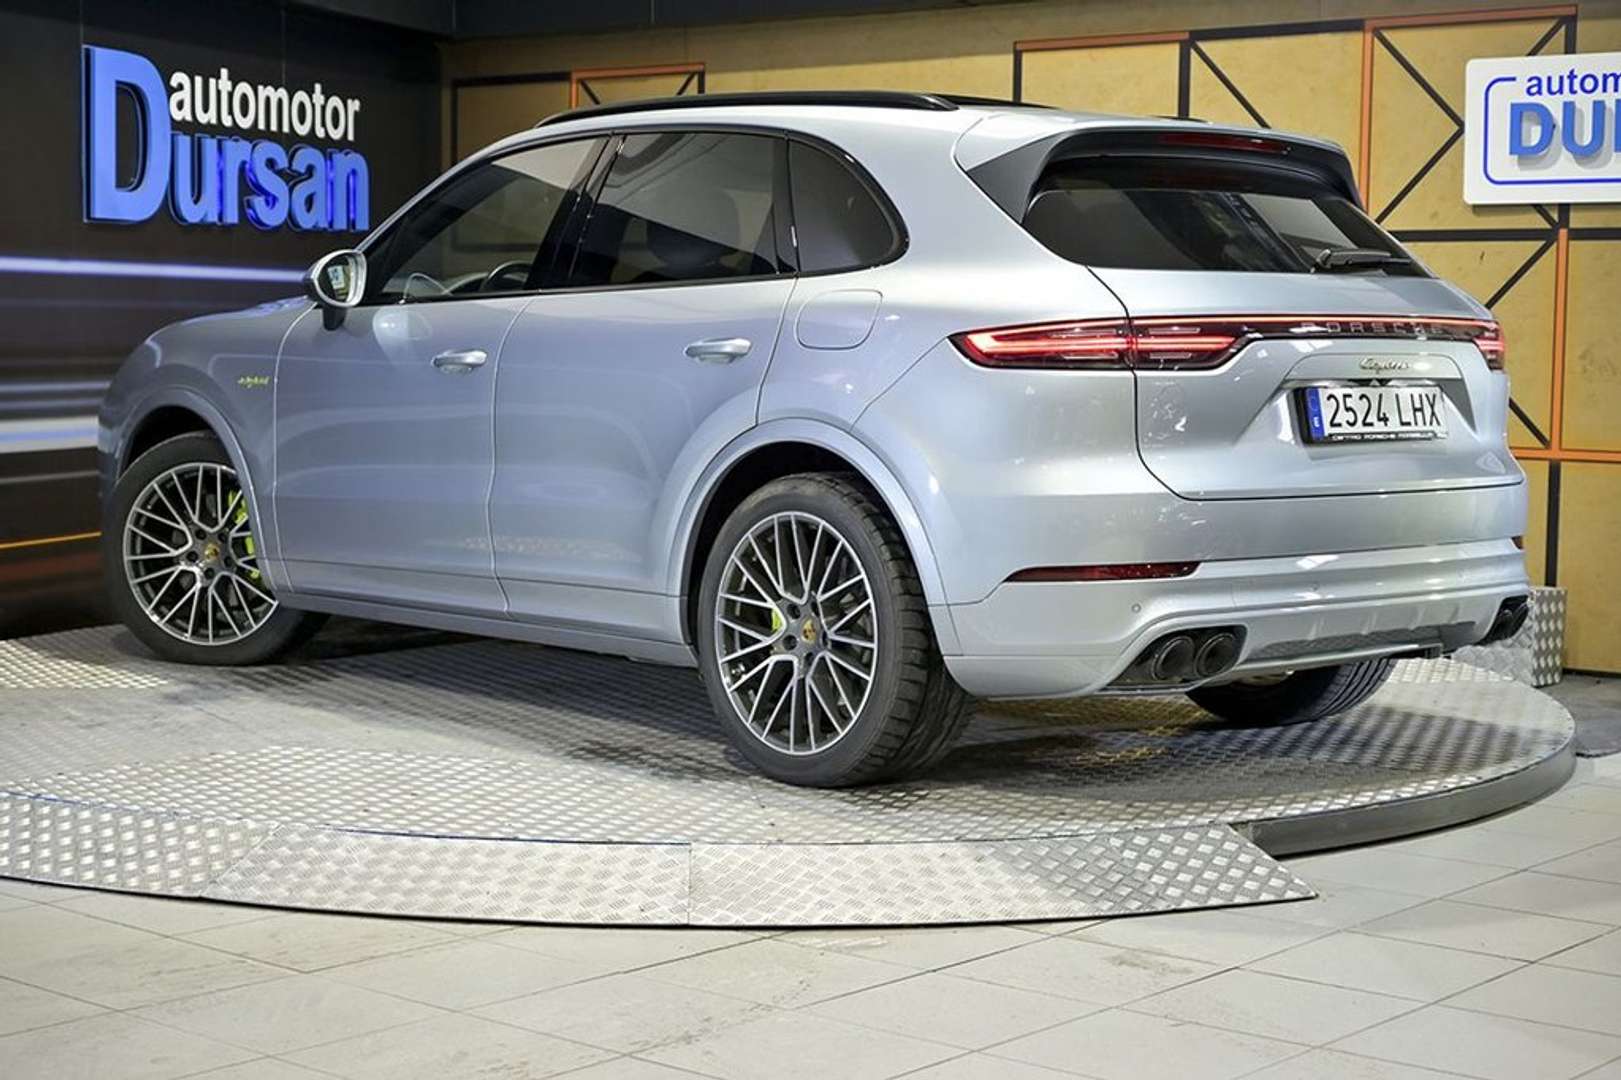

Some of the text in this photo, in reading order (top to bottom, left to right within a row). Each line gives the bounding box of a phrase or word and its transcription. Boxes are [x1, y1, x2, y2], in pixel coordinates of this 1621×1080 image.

[169, 67, 360, 141] automotor
[1509, 99, 1621, 157] DU
[82, 44, 370, 231] Dursan
[1327, 393, 1441, 428] 2524 LHX
